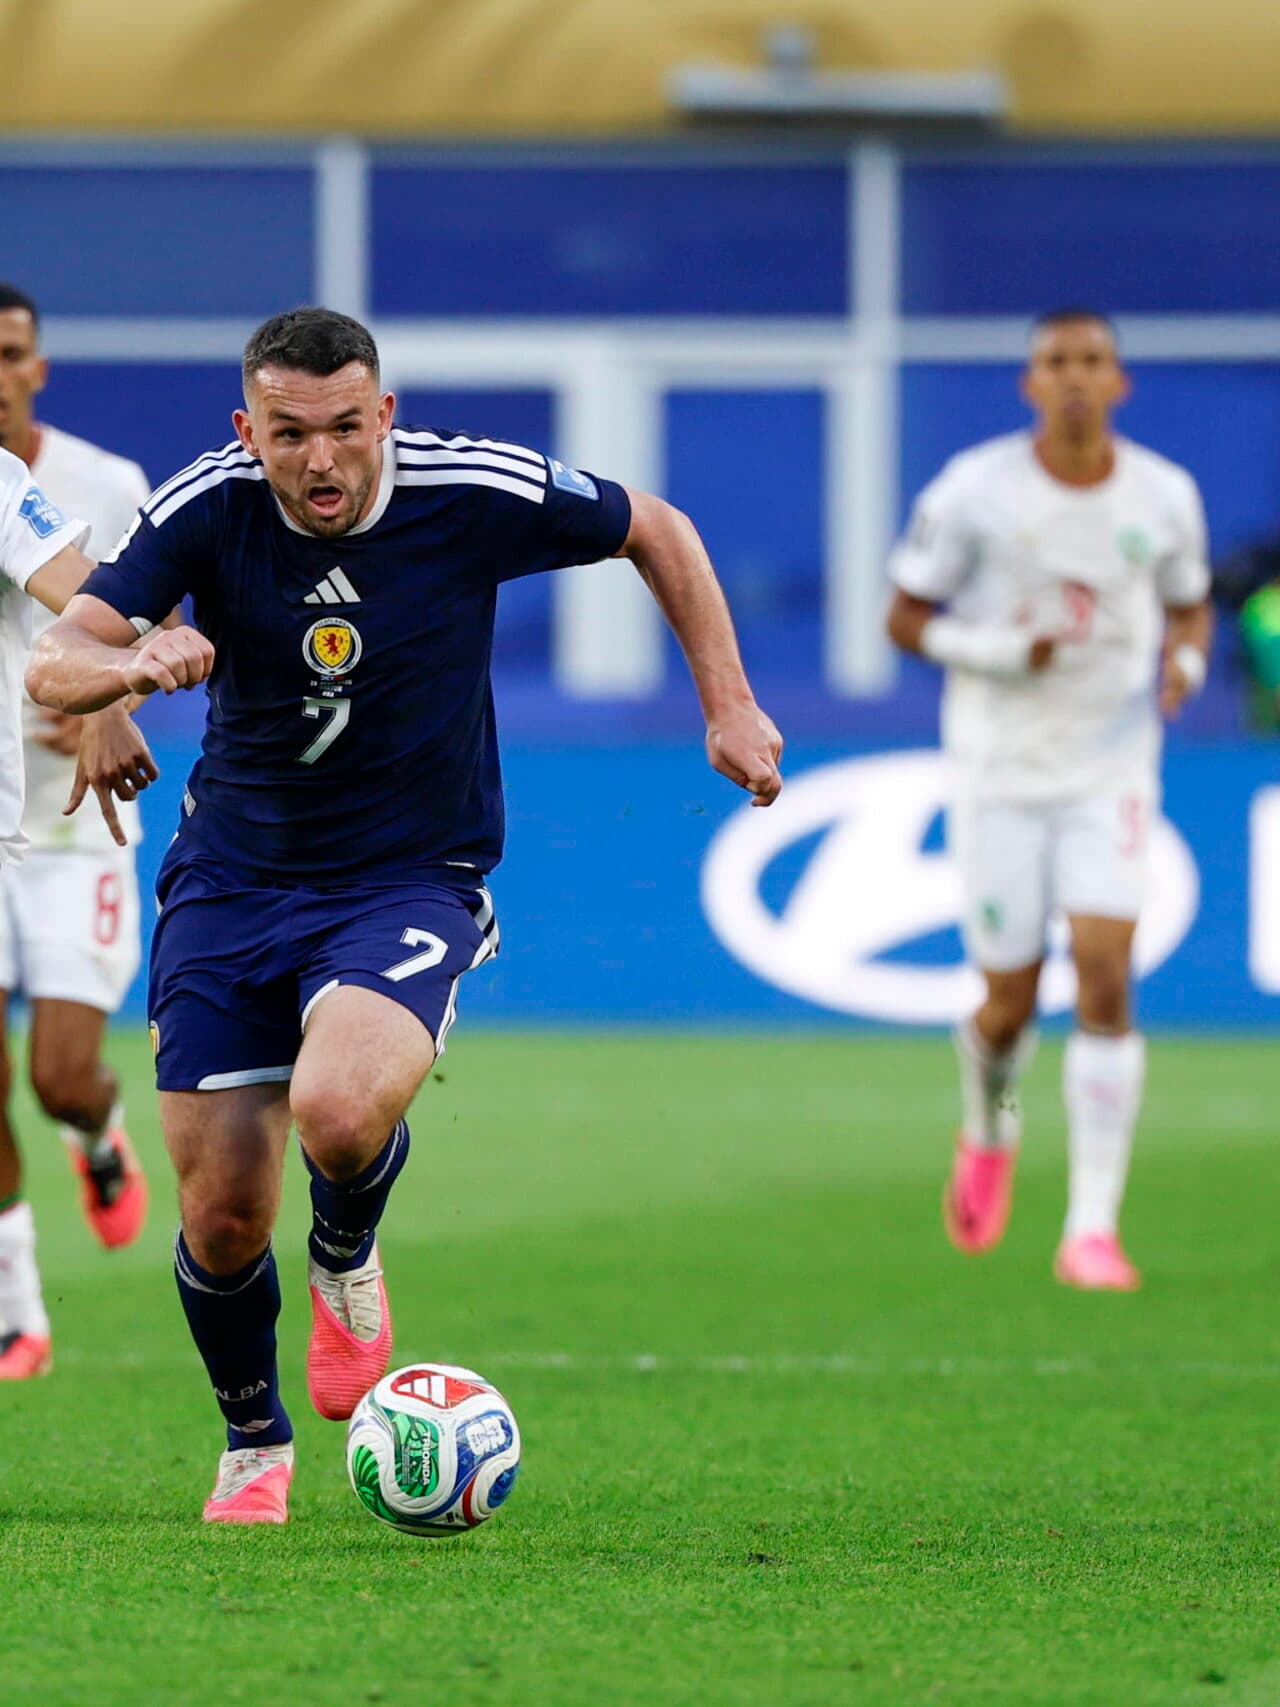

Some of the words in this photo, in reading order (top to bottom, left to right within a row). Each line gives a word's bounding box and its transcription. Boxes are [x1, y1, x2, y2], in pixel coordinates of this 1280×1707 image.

[296, 696, 351, 765] 7
[93, 871, 122, 947] 8
[381, 926, 449, 982] 7
[421, 1430, 432, 1486] TRIONDA
